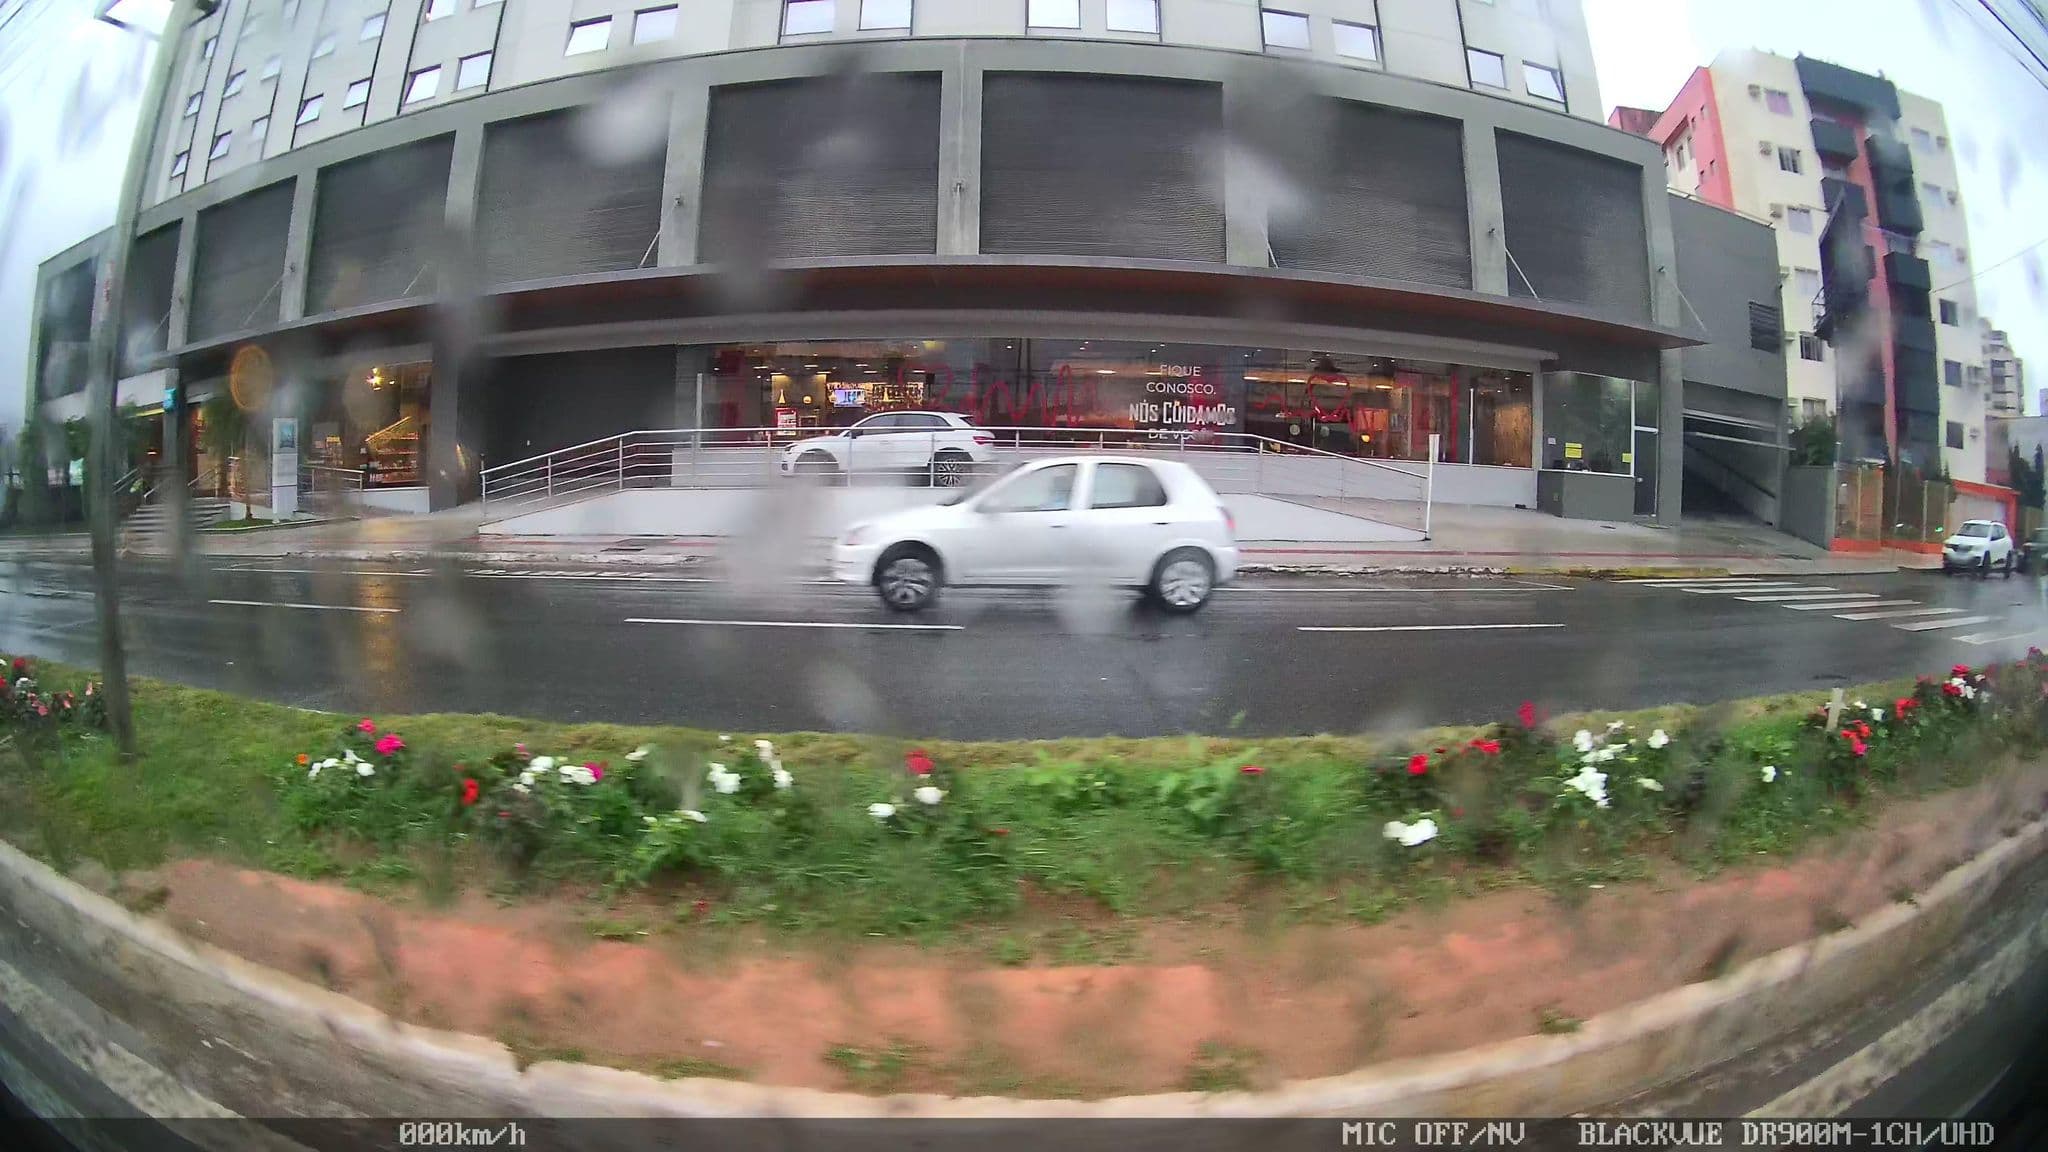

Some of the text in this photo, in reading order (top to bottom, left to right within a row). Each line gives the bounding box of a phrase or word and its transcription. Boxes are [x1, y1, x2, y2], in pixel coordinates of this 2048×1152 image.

[1160, 364, 1202, 378] FIQUE
[1146, 382, 1217, 395] CONOSCO.
[1128, 399, 1159, 423] NÓS
